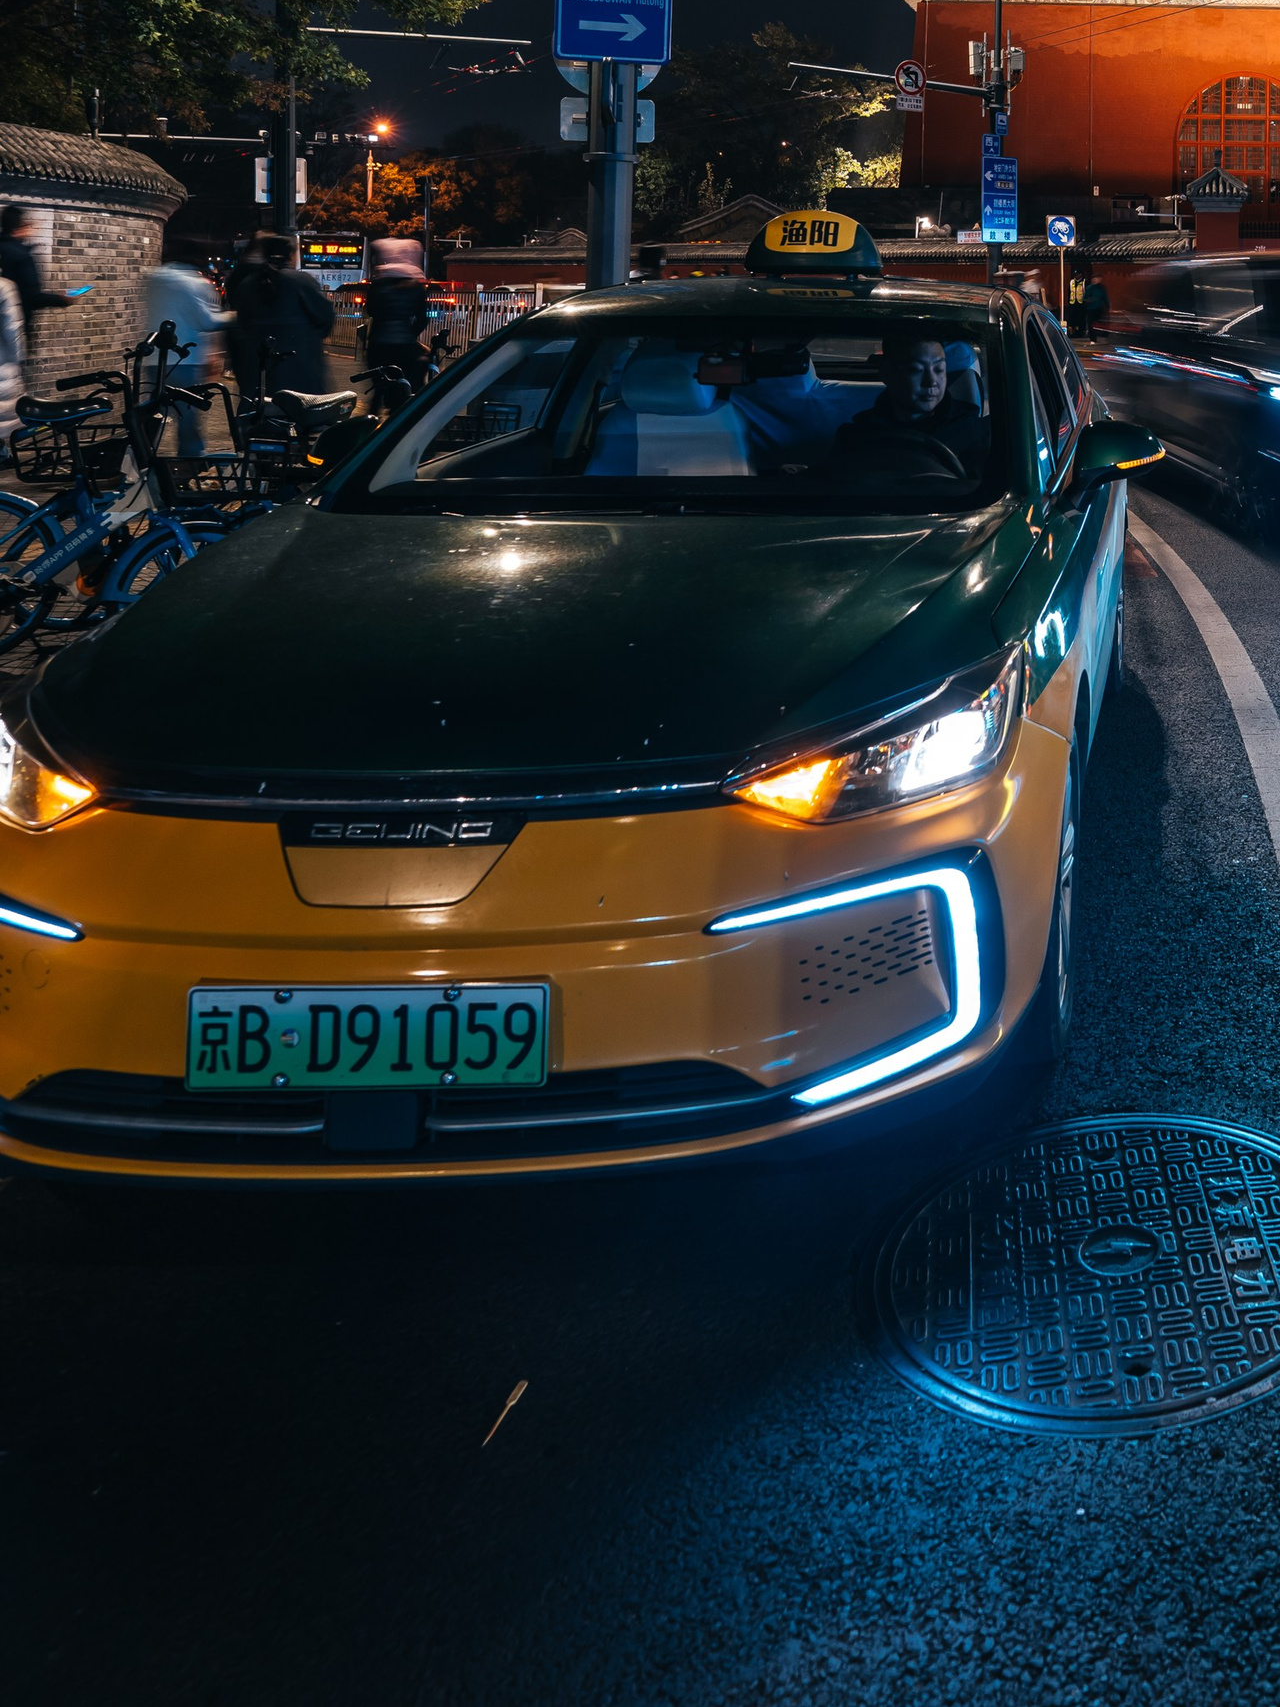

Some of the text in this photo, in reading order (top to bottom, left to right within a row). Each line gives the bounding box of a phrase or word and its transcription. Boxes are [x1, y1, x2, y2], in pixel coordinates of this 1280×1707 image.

[780, 220, 839, 247] 渔阳
[311, 821, 493, 839] BEIJING
[1205, 1175, 1275, 1298] 北京电力
